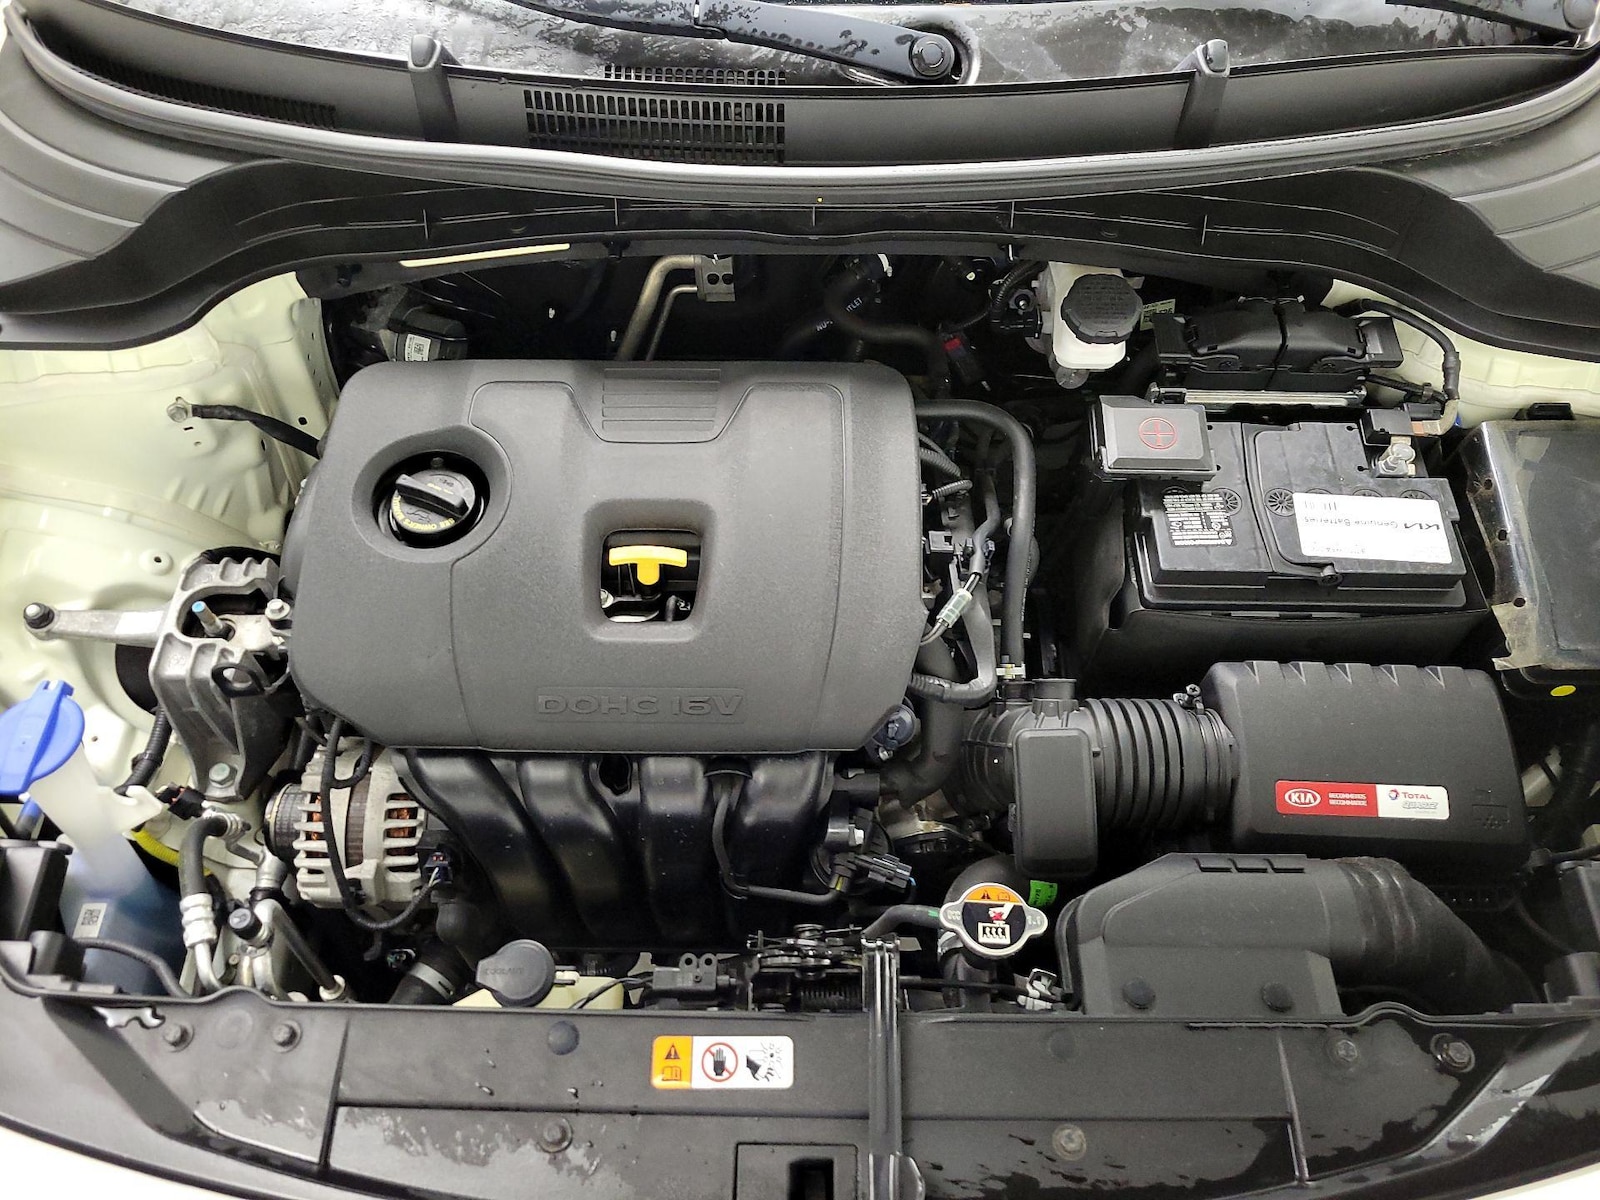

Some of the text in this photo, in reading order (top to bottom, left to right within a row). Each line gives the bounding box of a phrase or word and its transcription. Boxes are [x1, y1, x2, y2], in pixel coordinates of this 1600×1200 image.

[537, 694, 744, 716] DOHC 16V
[1289, 791, 1316, 804] KIA
[1401, 791, 1432, 800] TOTAL
